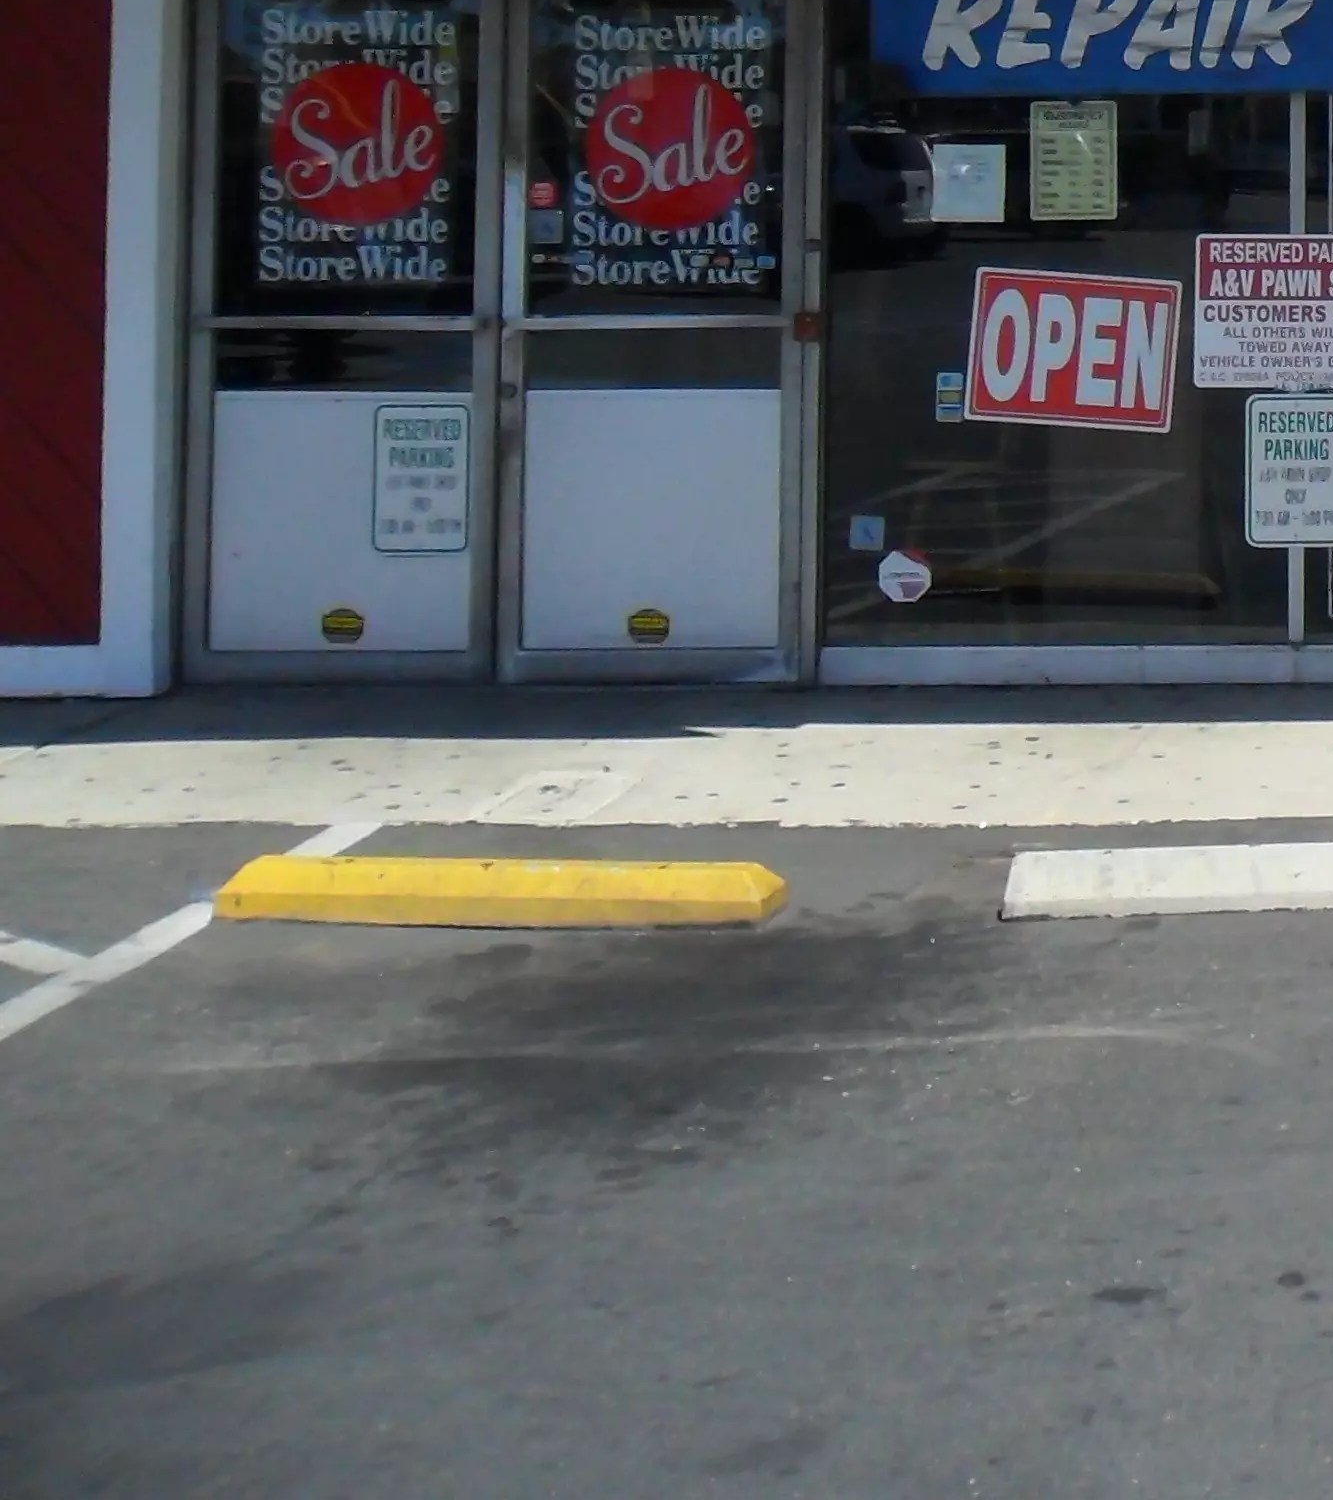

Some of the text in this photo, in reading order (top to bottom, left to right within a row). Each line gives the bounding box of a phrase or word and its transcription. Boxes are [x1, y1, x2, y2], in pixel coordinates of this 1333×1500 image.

[285, 79, 437, 199] Sale
[597, 83, 748, 204] Sale
[1209, 242, 1303, 263] RESERVED
[1209, 269, 1255, 297] A&V
[1261, 269, 1321, 297] PAWN
[1203, 305, 1327, 323] CUSTOMERS
[1223, 327, 1247, 338] ALL
[1252, 327, 1306, 339] OTHERS
[982, 288, 1168, 411] OPEN
[1238, 341, 1287, 353] TOWED
[1291, 341, 1331, 353] AWAY
[1200, 356, 1255, 368] VEHICLE
[1264, 439, 1329, 461] PARKING
